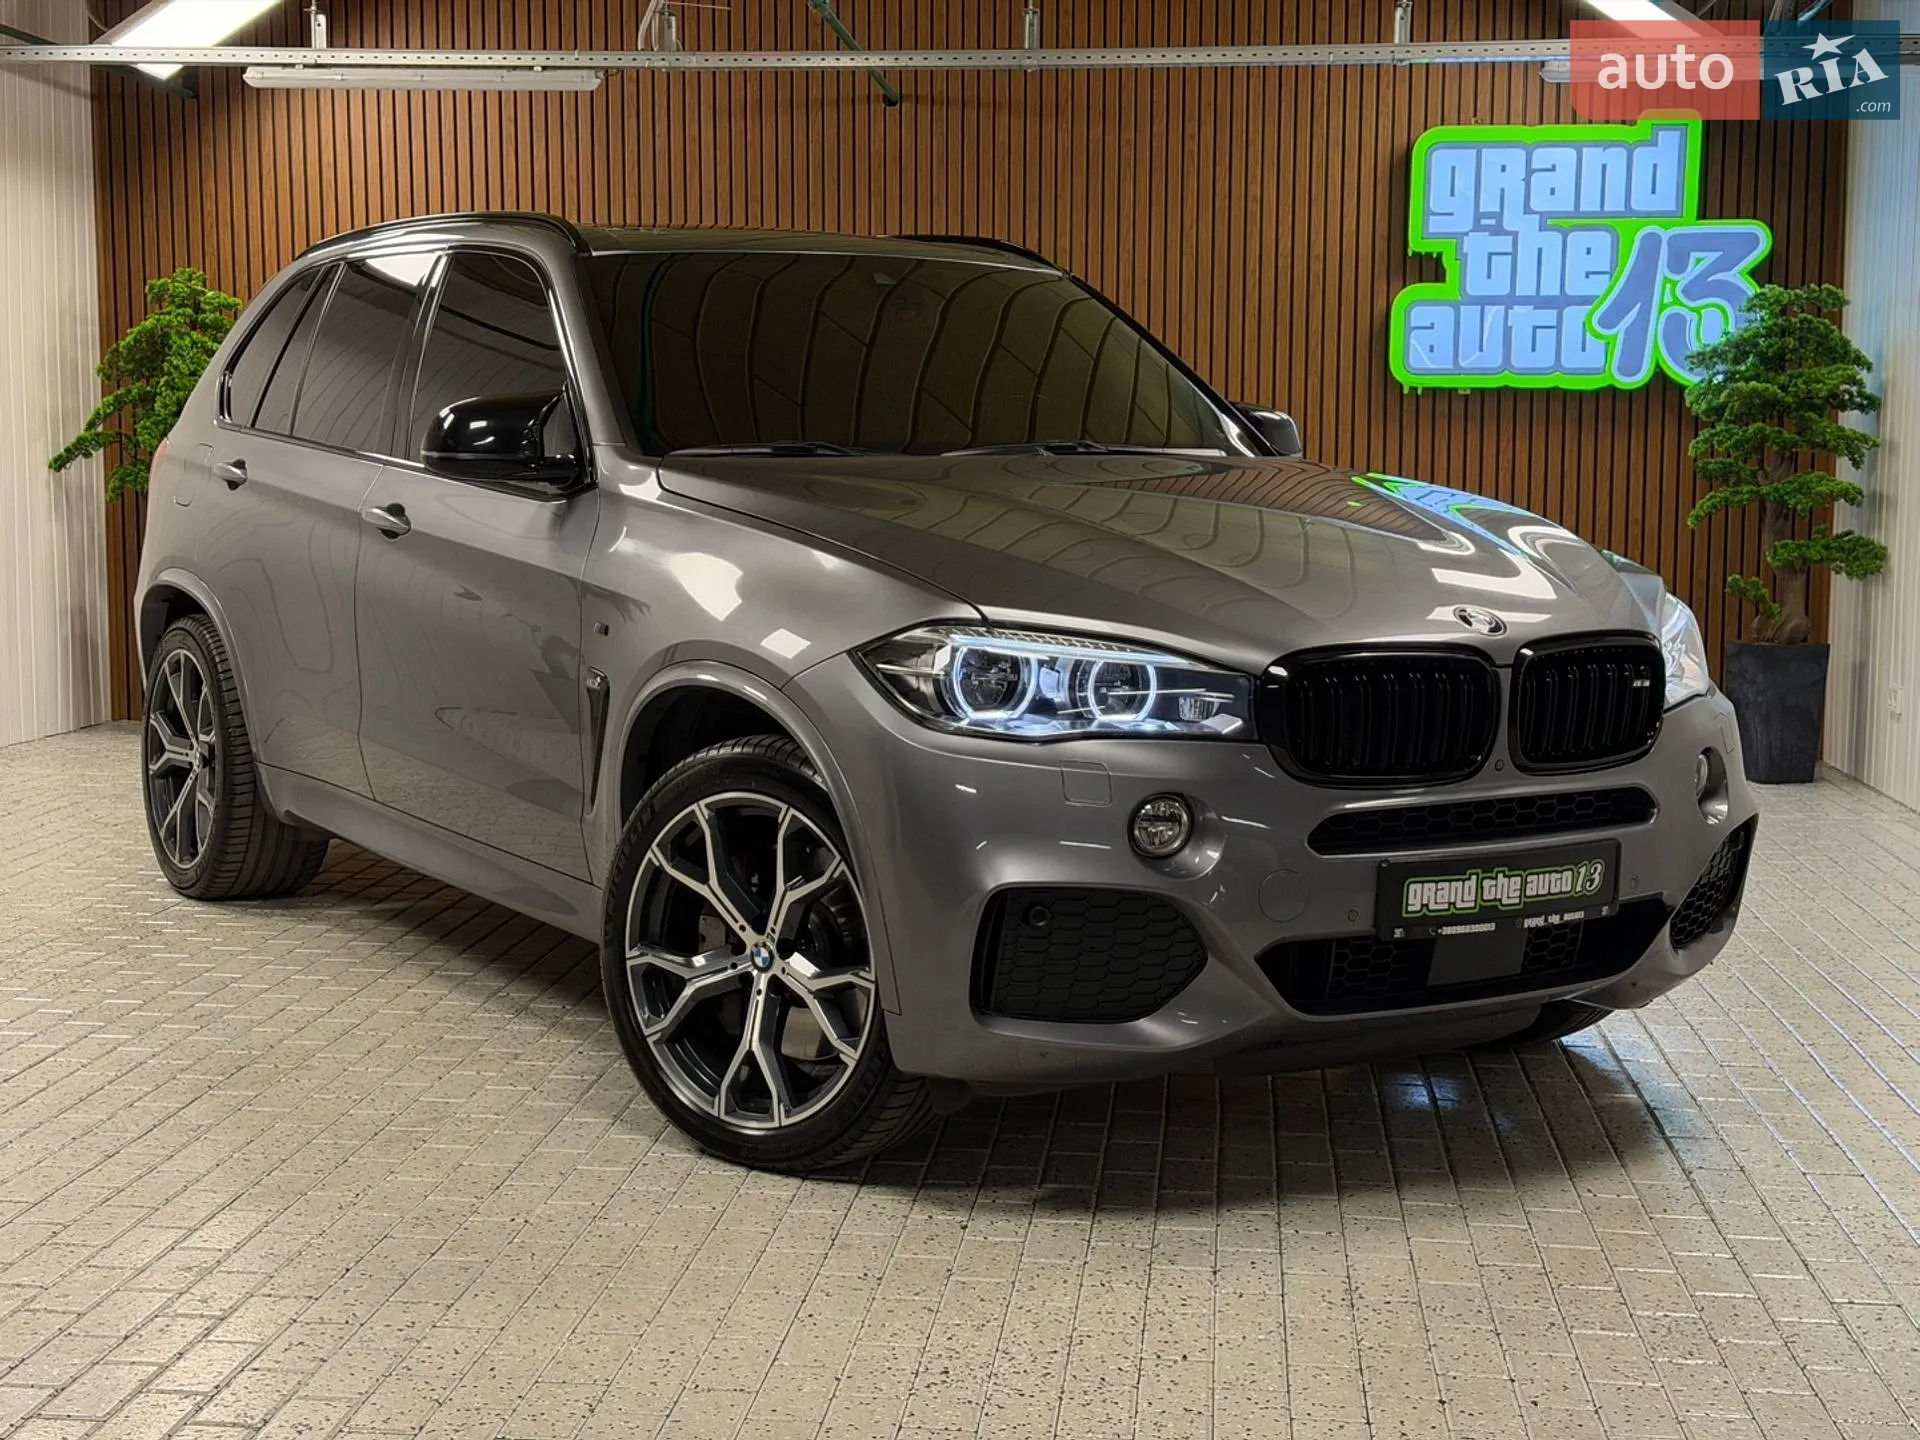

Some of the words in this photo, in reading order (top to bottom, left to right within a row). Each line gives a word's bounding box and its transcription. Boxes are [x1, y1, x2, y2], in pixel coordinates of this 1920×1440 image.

[1428, 127, 1685, 233] grand
[1463, 216, 1614, 297] the
[1408, 305, 1607, 370] auto
[1594, 226, 1768, 382] 13
[1407, 874, 1477, 912] grand
[1482, 869, 1522, 904] the
